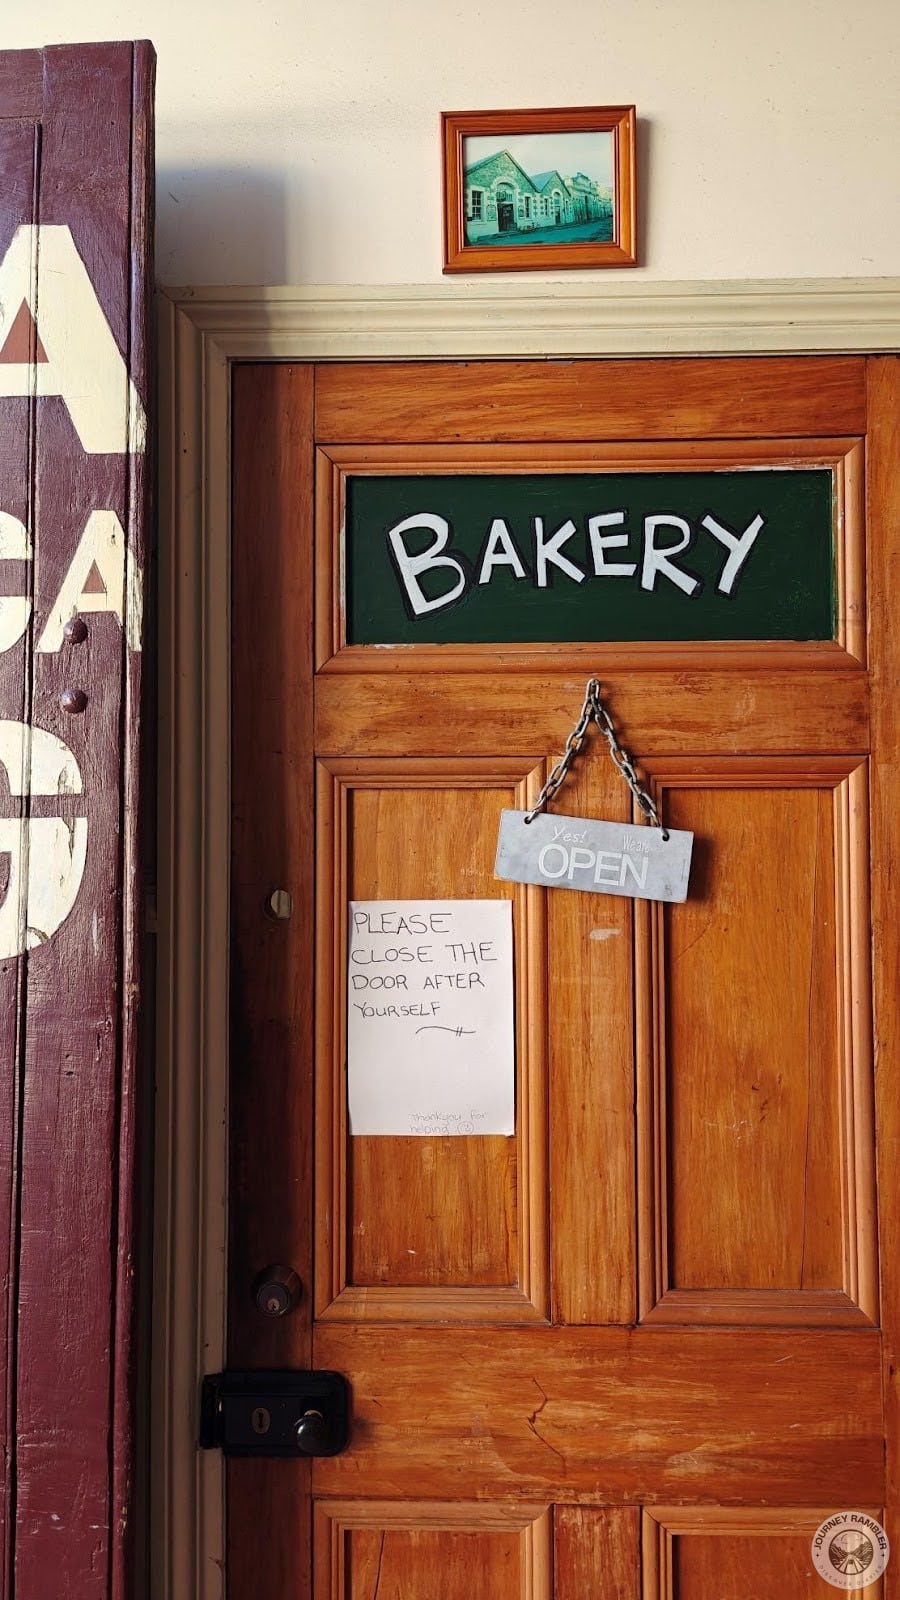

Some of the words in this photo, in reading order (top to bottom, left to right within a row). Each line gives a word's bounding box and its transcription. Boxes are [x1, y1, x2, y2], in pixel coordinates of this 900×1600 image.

[387, 510, 766, 617] BAKERY
[551, 825, 588, 844] Yes!
[538, 843, 649, 890] OPEN
[353, 911, 452, 936] PLEASE
[351, 945, 433, 965] CLOSE
[445, 941, 498, 965] THE
[352, 974, 409, 990] DOOR
[423, 972, 485, 990] AFTER
